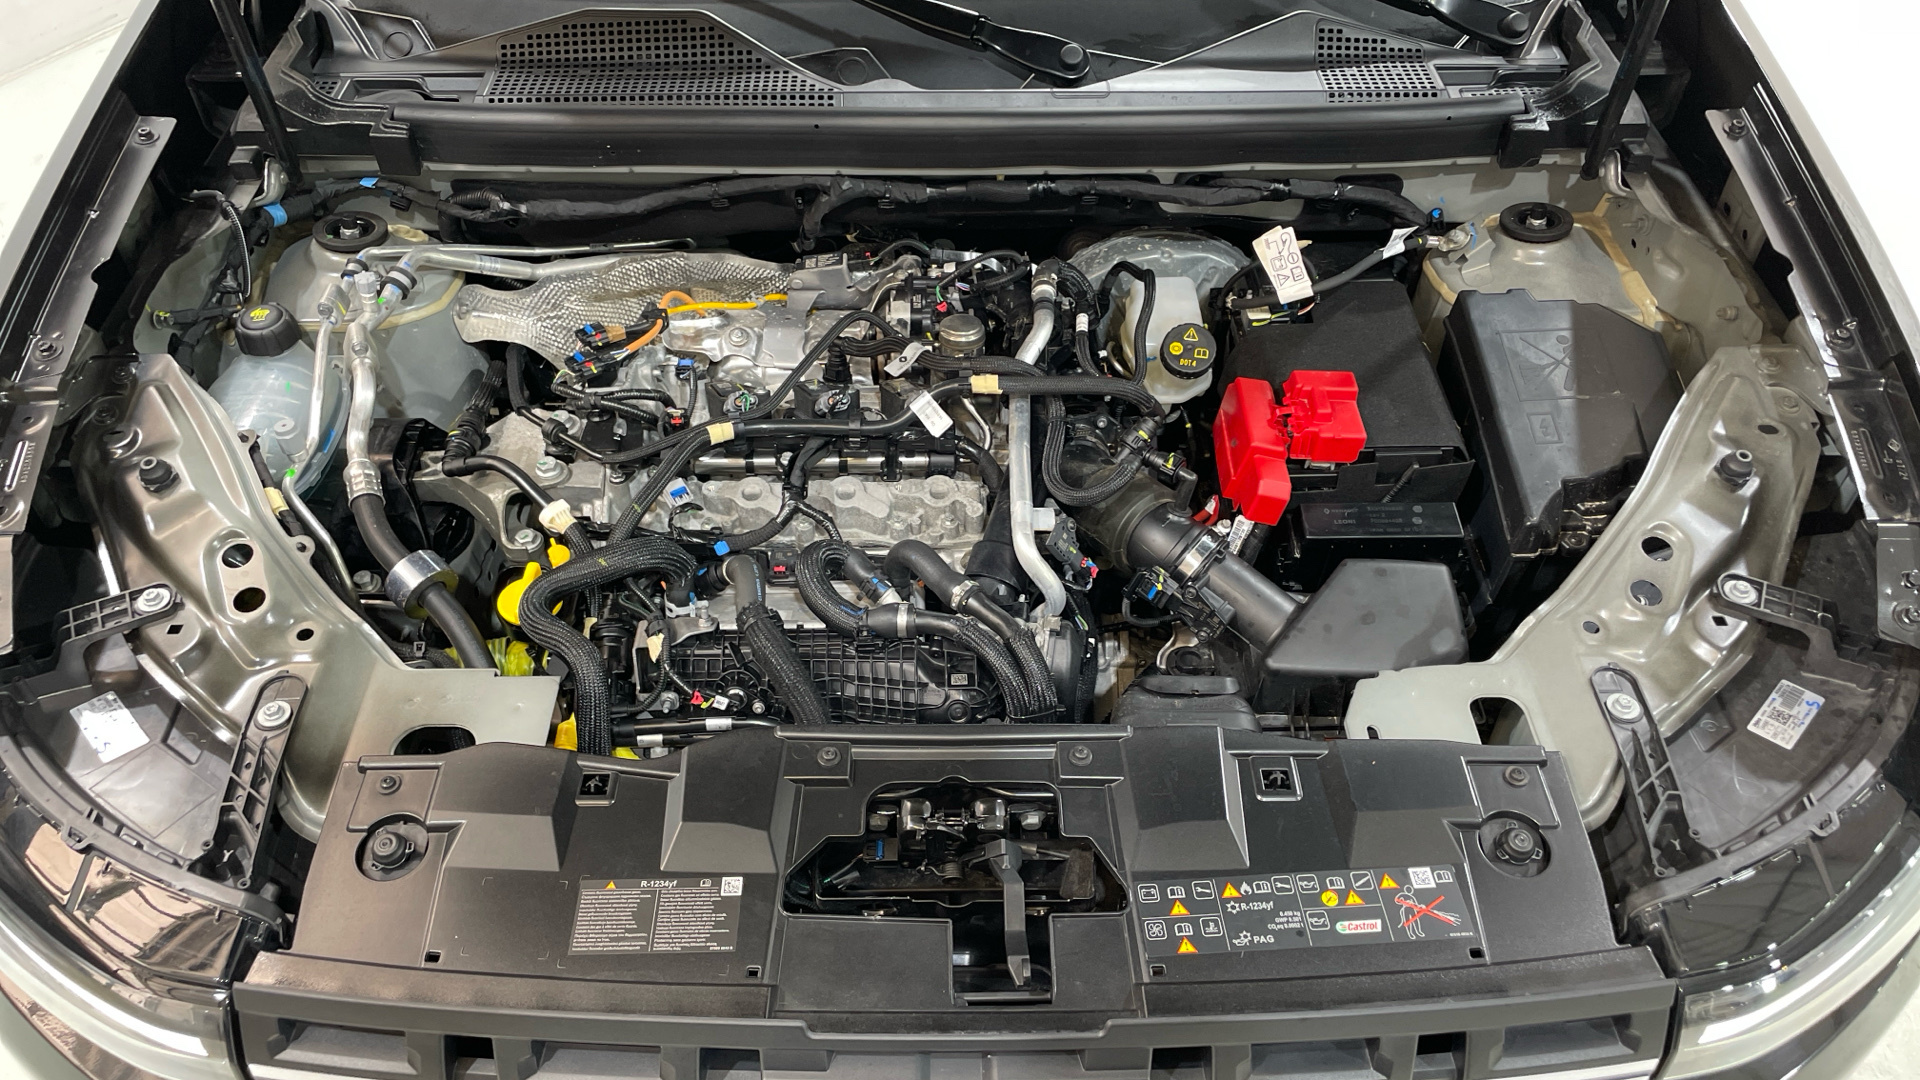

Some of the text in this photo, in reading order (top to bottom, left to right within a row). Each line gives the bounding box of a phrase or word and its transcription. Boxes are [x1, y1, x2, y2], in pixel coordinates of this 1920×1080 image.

[640, 880, 678, 889] R-1234yf
[1240, 901, 1274, 911] R-1234yf
[1347, 921, 1378, 932] Castrol
[1253, 934, 1275, 944] PAG
